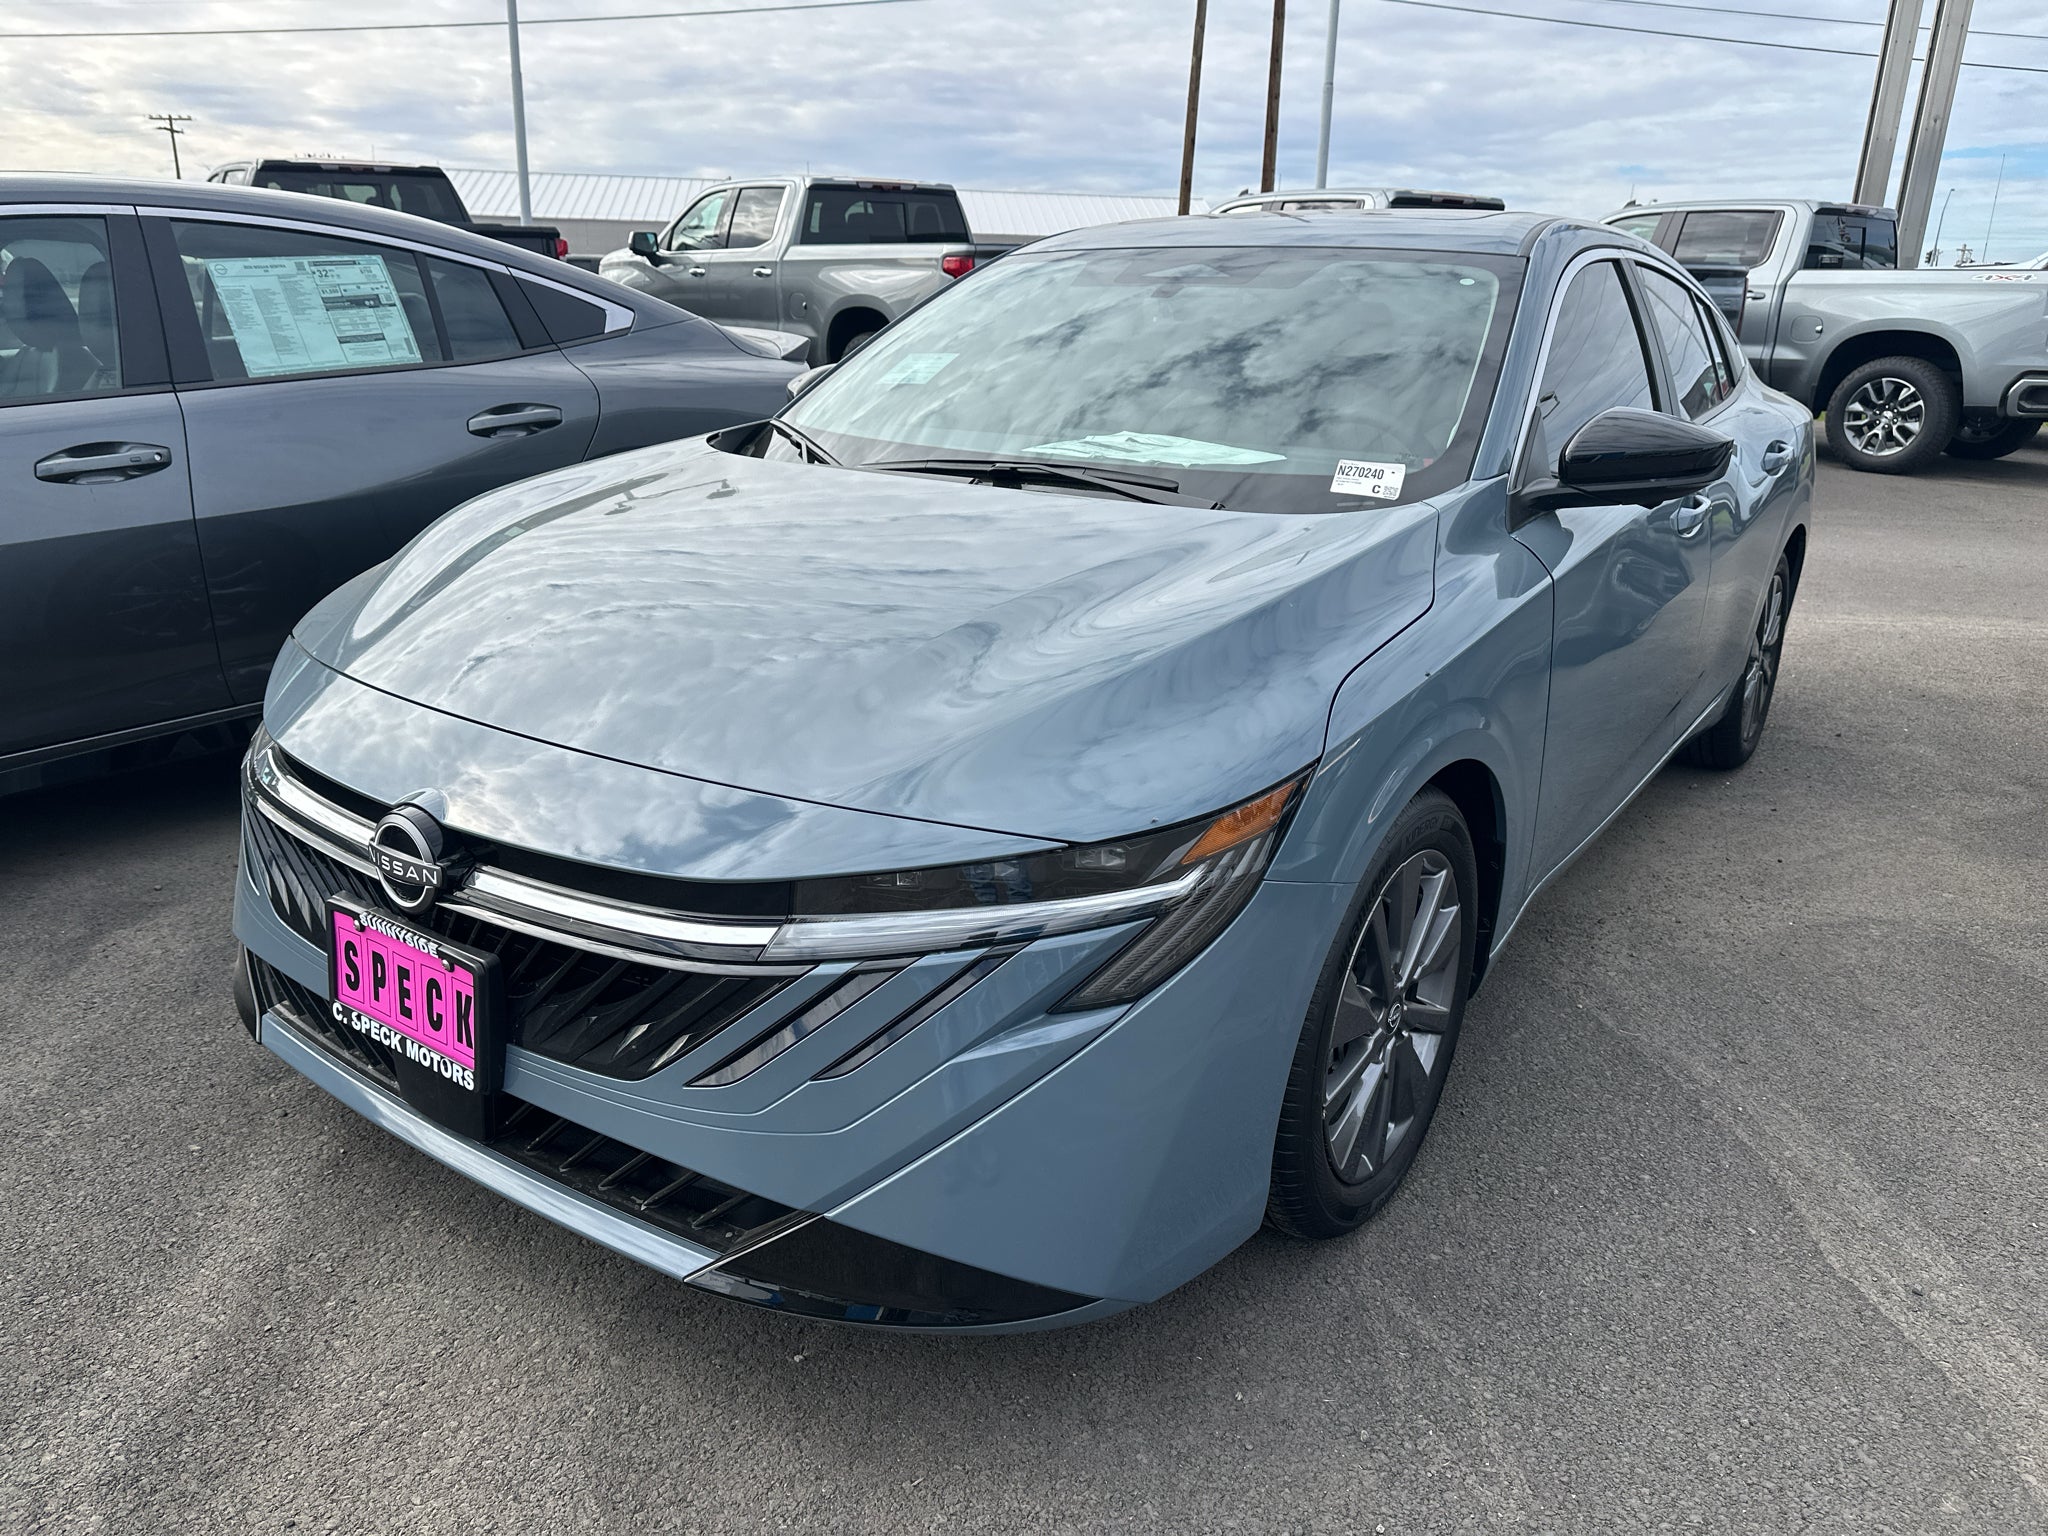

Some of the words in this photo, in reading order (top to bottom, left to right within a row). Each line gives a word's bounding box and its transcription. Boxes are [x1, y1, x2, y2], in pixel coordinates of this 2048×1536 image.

[1337, 464, 1385, 480] N270240
[1371, 484, 1381, 494] C
[369, 846, 437, 885] NISSAN
[359, 911, 440, 959] SUNNYSIDE
[344, 940, 474, 1050] SPECK
[332, 1001, 348, 1024] C.
[351, 1011, 402, 1053] SPECK
[406, 1038, 475, 1092] MOTORS
